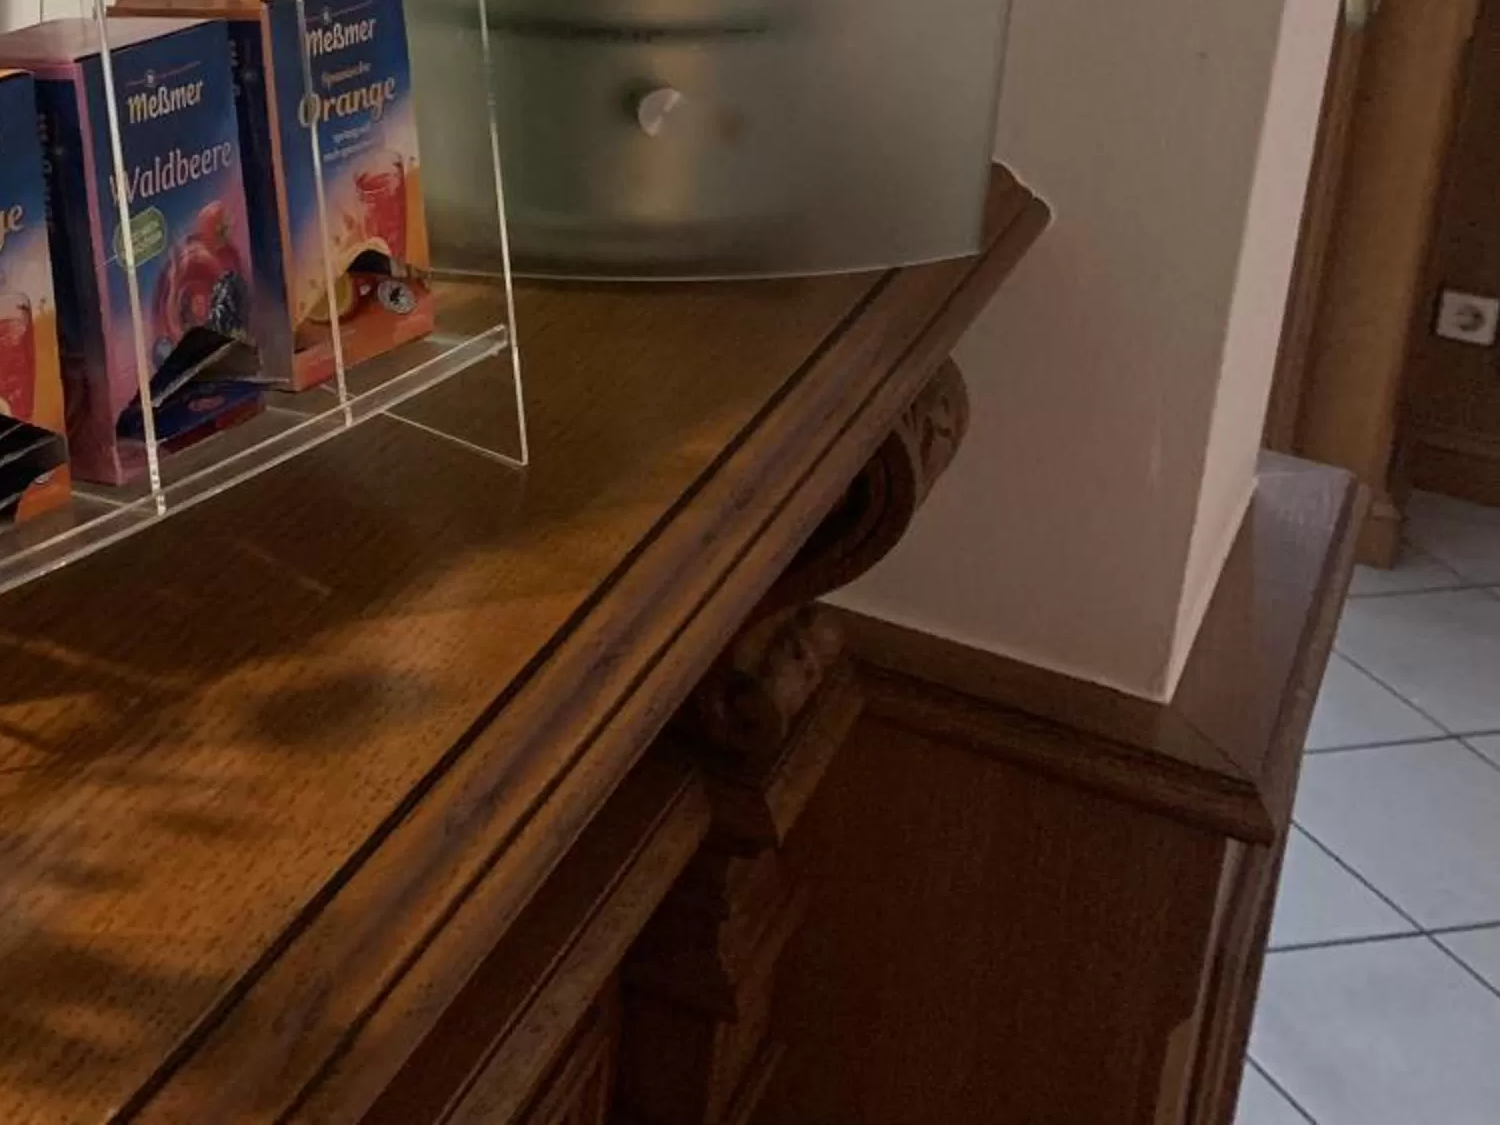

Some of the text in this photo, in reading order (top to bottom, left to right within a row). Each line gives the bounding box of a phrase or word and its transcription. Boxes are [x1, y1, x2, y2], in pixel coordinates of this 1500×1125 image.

[305, 18, 377, 58] Meßmer
[126, 81, 204, 124] Meßmer
[297, 76, 397, 128] Orange
[109, 140, 232, 205] Waldbeere
